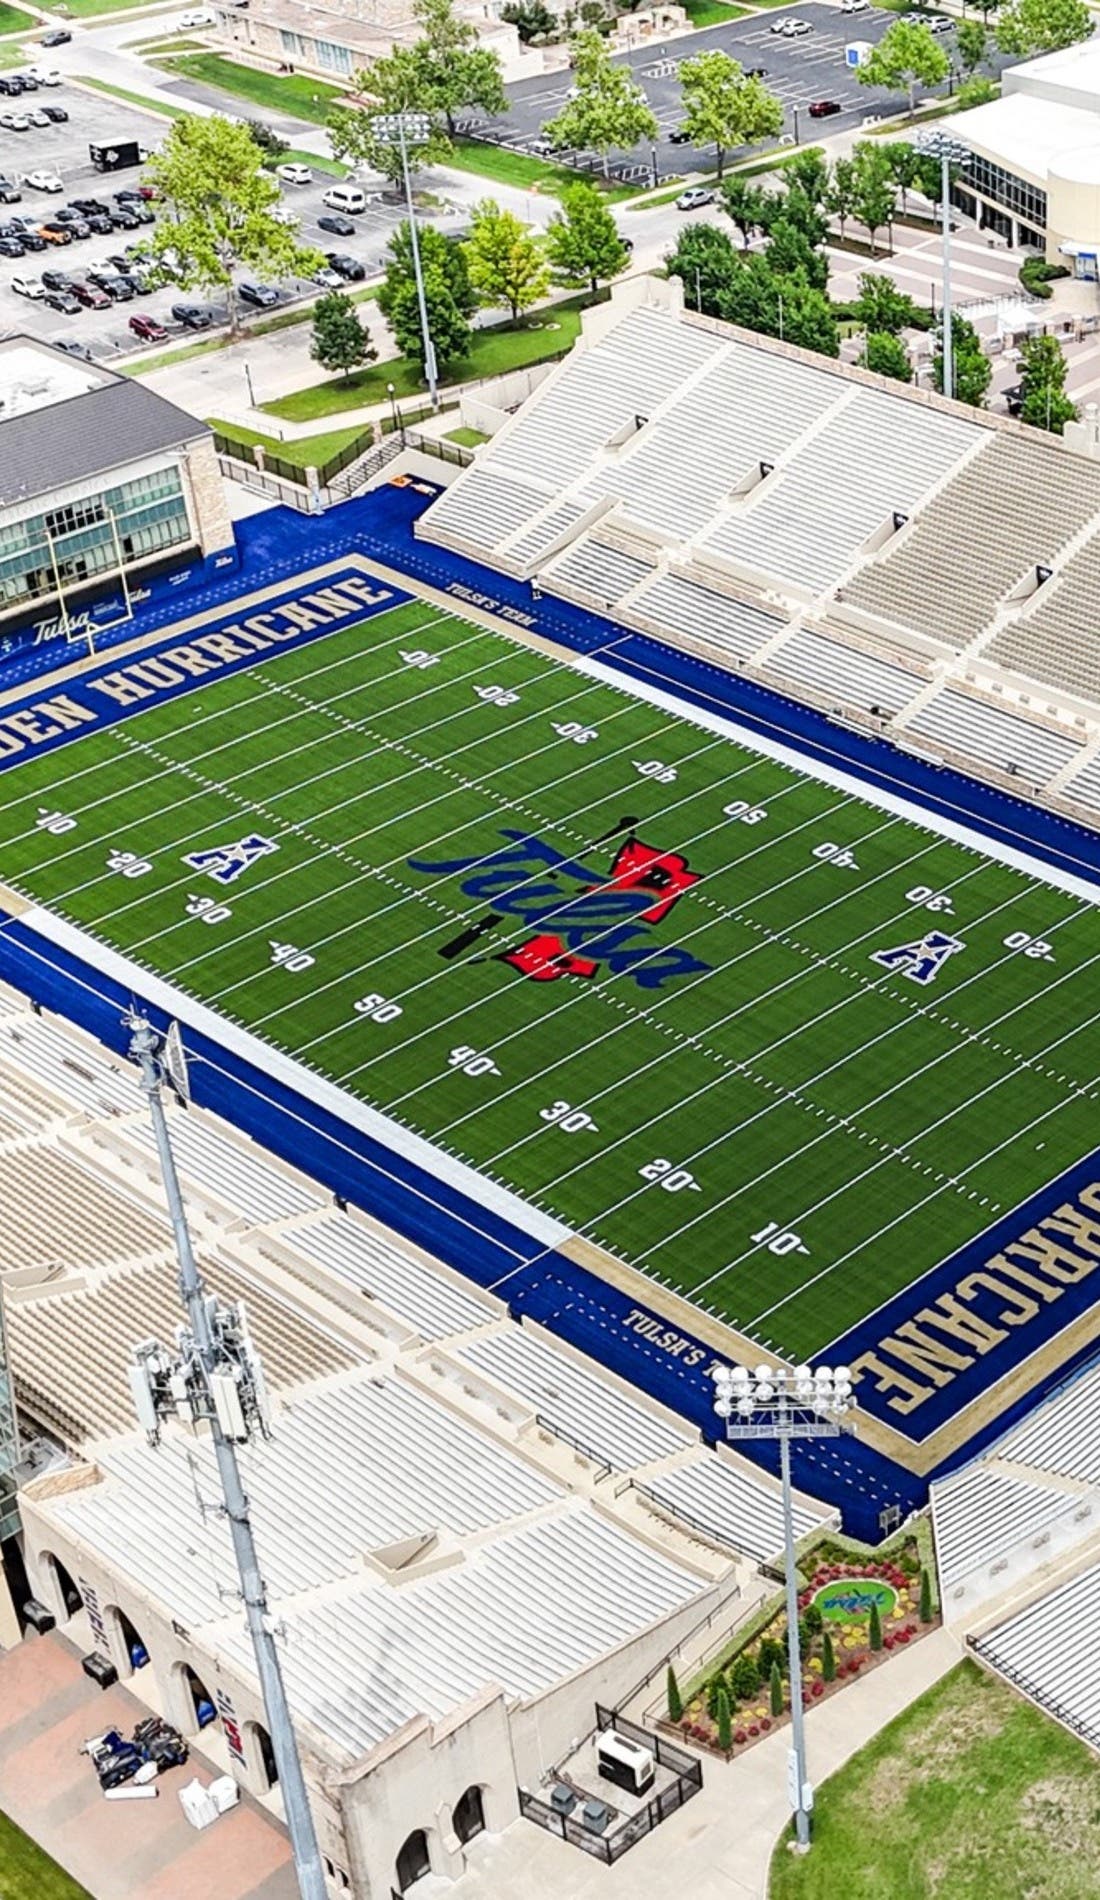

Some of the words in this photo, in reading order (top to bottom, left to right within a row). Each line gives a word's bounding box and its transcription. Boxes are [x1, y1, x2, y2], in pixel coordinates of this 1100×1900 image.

[445, 582, 501, 609] TULSA'S
[32, 611, 90, 646] Tulsa
[0, 694, 99, 759] EN
[86, 577, 394, 706] HURRICANE
[403, 651, 440, 669] 10
[476, 685, 521, 706] 20
[555, 721, 598, 744] 30
[636, 761, 677, 784] 40
[36, 811, 77, 835] 10
[723, 800, 768, 825] 50
[105, 853, 153, 878] 20
[812, 842, 854, 867] 40
[185, 898, 232, 924] 30
[407, 829, 715, 988] Tulsa
[905, 885, 951, 911] 30
[271, 944, 315, 972] 40
[1003, 931, 1053, 958] 20
[354, 993, 403, 1024] 50
[447, 1045, 494, 1077] 40
[539, 1101, 590, 1133] 30
[638, 1159, 692, 1193] 20
[750, 1222, 802, 1256] 10
[848, 1182, 1100, 1416] RRICANE
[622, 1309, 706, 1366] TULSA'S
